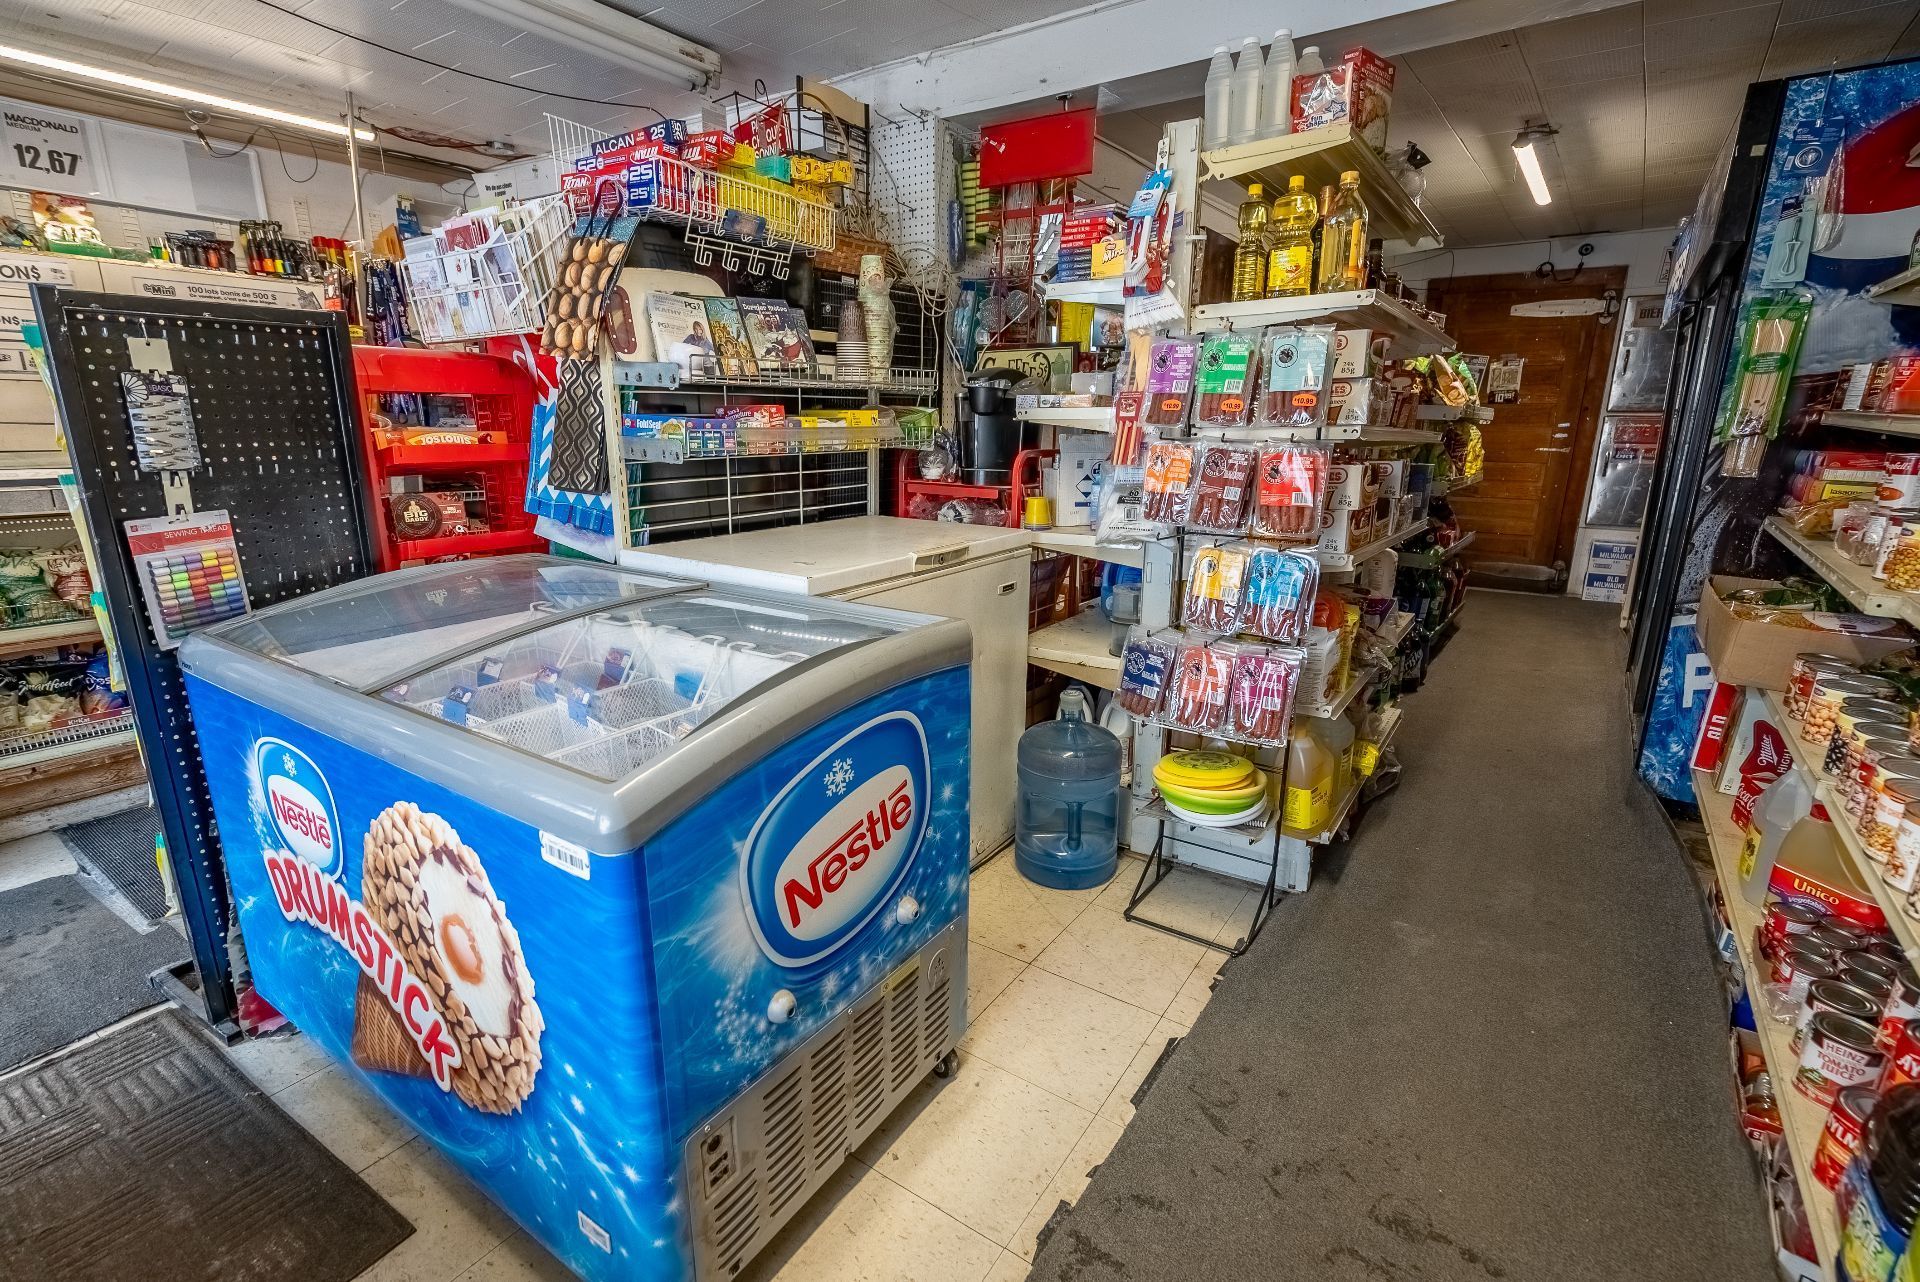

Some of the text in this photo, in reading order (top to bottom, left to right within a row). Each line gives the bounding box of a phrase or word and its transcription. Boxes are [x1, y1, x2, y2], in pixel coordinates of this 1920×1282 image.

[3, 112, 79, 133] MACDONALD
[6, 121, 41, 132] MEDIUM
[595, 124, 666, 156] ALCAN 25'
[13, 143, 79, 176] 12,67
[562, 175, 588, 191] TITAN
[400, 214, 417, 222] Advil
[187, 286, 203, 294] 100
[220, 289, 241, 297] bonis
[252, 292, 269, 300] 500
[404, 510, 428, 518] BIG
[164, 527, 198, 539] SEWING
[1757, 734, 1779, 767] Miller
[271, 788, 332, 850] Nestlé
[783, 778, 912, 929] Nestlé
[1793, 877, 1840, 905] Unico
[1787, 895, 1827, 913] Vegetable
[266, 855, 457, 1084] DRUMSTICK
[1824, 1040, 1866, 1064] HEINZ
[1816, 1051, 1866, 1077] TOMATO
[1820, 1062, 1856, 1082] JUICE
